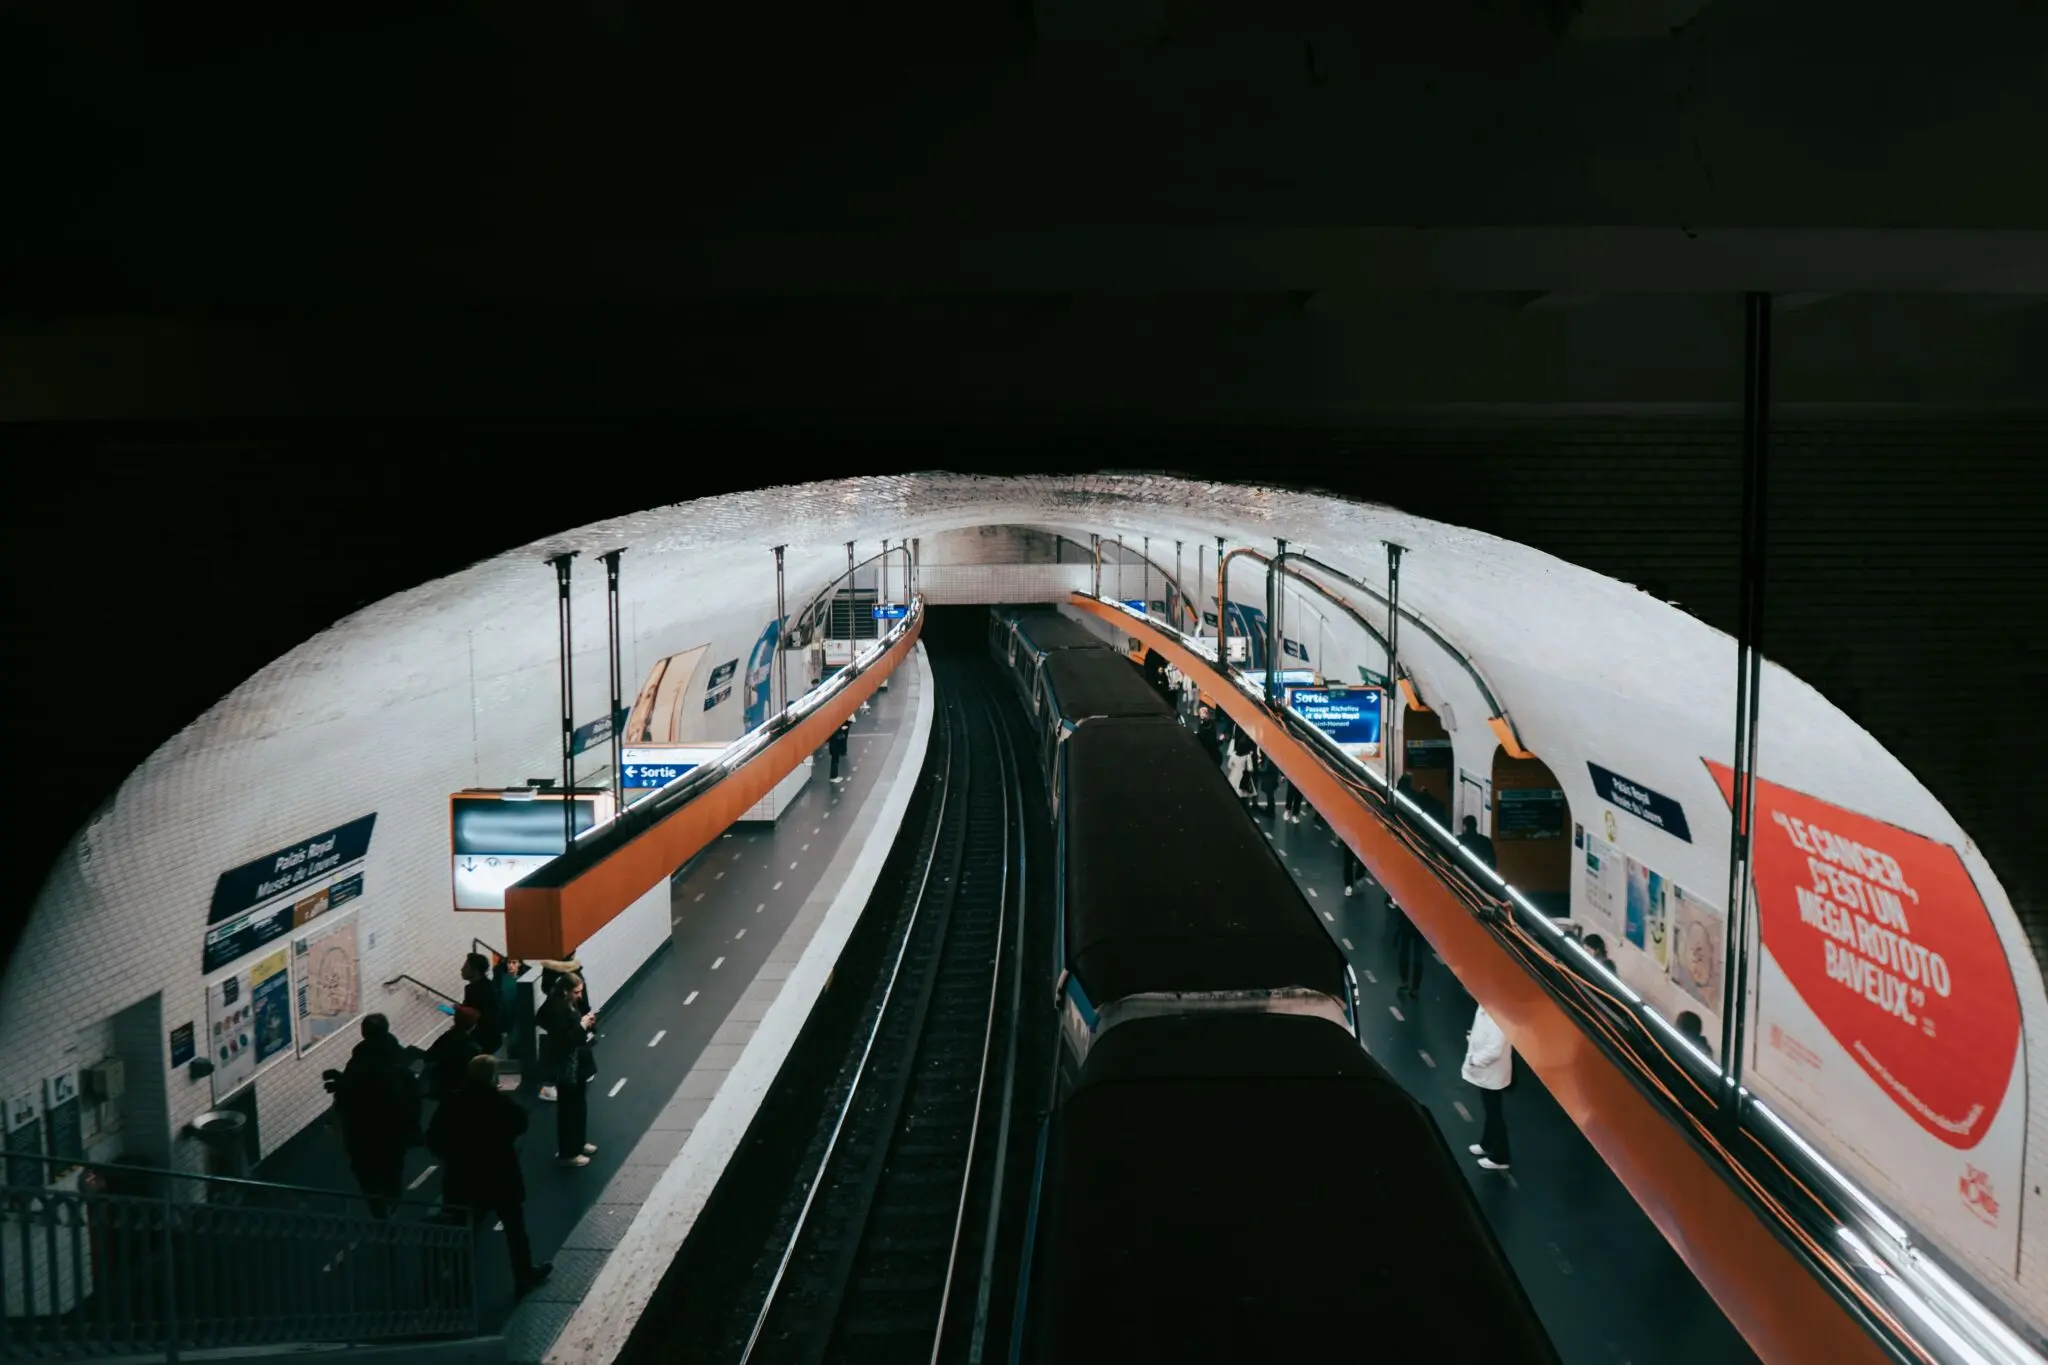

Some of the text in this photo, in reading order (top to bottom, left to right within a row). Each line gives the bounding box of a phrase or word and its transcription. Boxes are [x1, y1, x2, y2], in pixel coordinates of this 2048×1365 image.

[1295, 692, 1329, 703] Sortie
[1341, 712, 1360, 720] Royal
[640, 766, 677, 778] Sortie
[651, 779, 658, 787] 7
[274, 834, 336, 873] Palais Royal
[1807, 823, 1920, 905] CANCER,
[255, 873, 293, 900] Musée
[307, 853, 340, 877] Louvre
[1864, 883, 1910, 934] UN
[1853, 913, 1951, 998] ROTOTO
